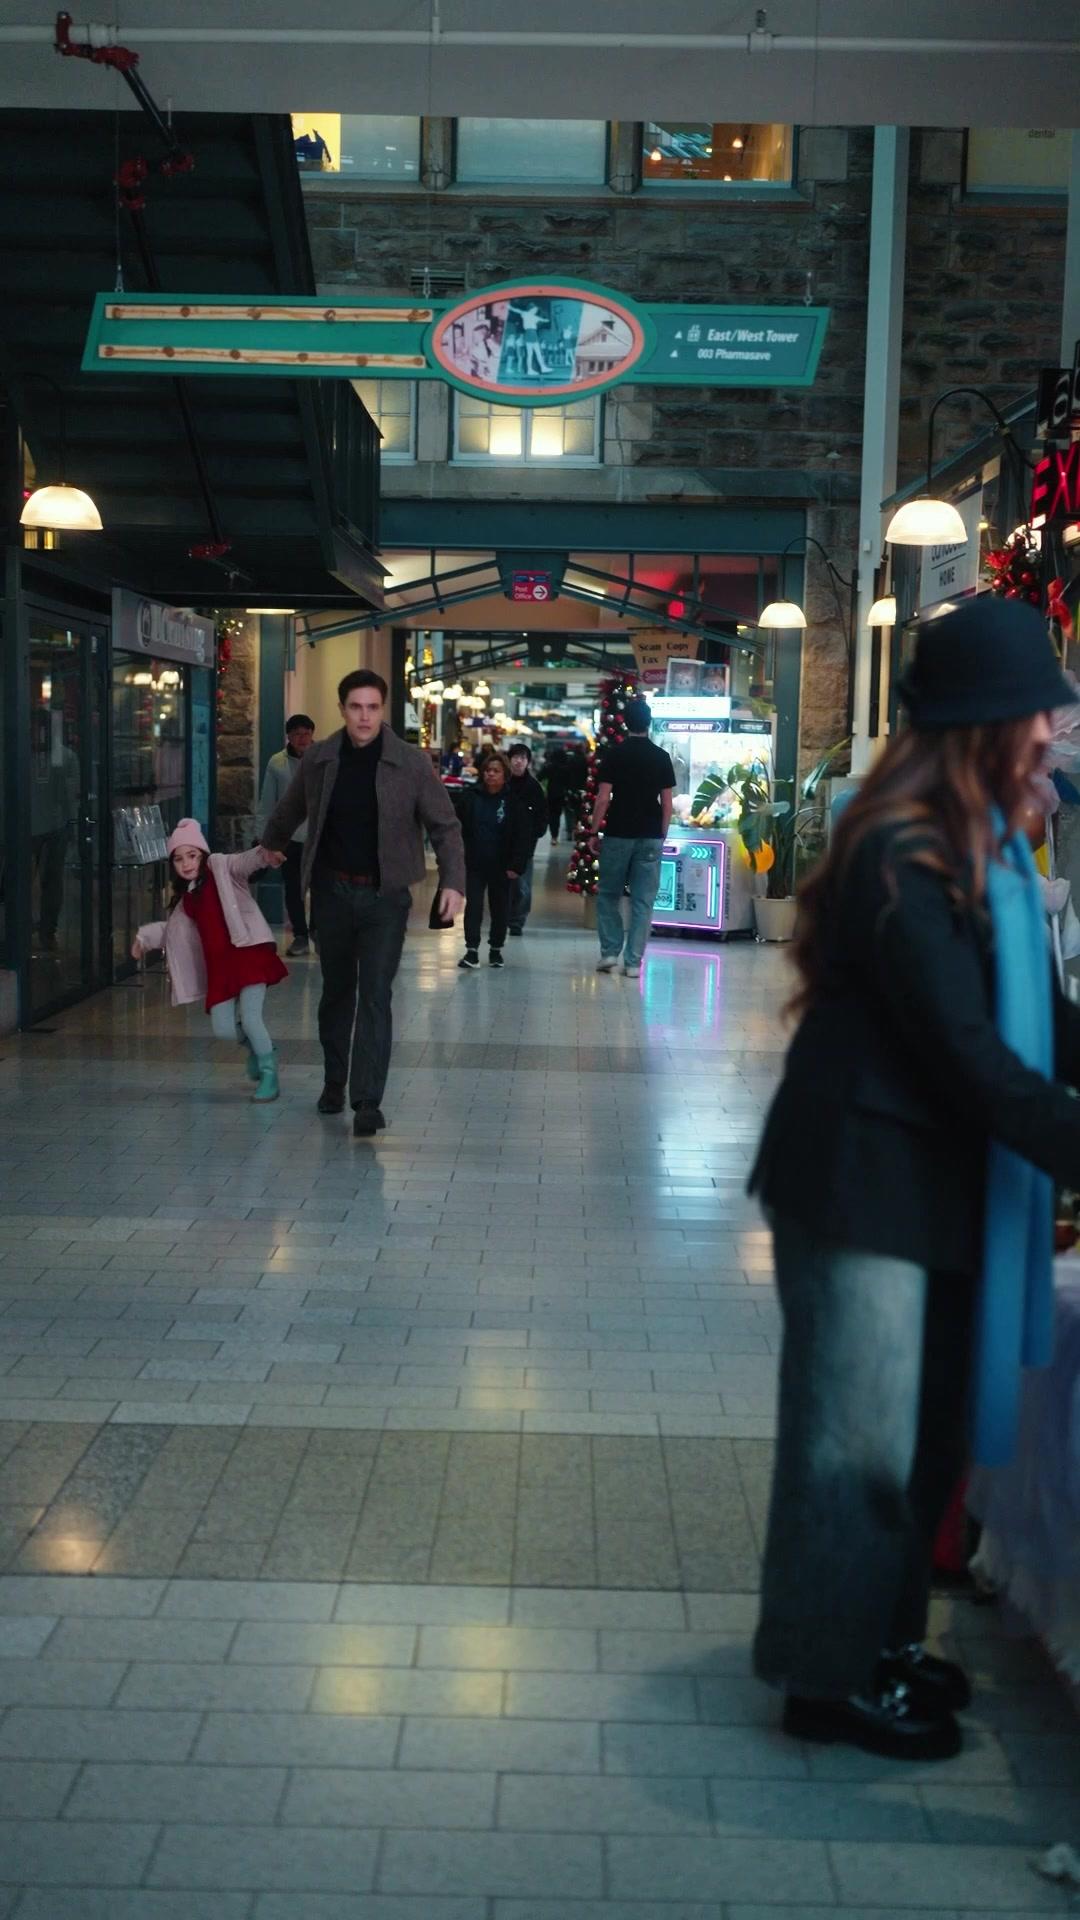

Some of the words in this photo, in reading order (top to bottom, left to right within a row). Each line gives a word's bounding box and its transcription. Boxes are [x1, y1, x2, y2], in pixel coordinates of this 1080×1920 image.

[707, 328, 764, 343] East/West
[766, 329, 799, 343] Tower
[697, 348, 713, 359] 003
[715, 348, 772, 361] Pharmasave
[514, 592, 532, 600] Office
[638, 642, 662, 651] Scan
[666, 641, 689, 652] Copy
[642, 656, 659, 664] Fax
